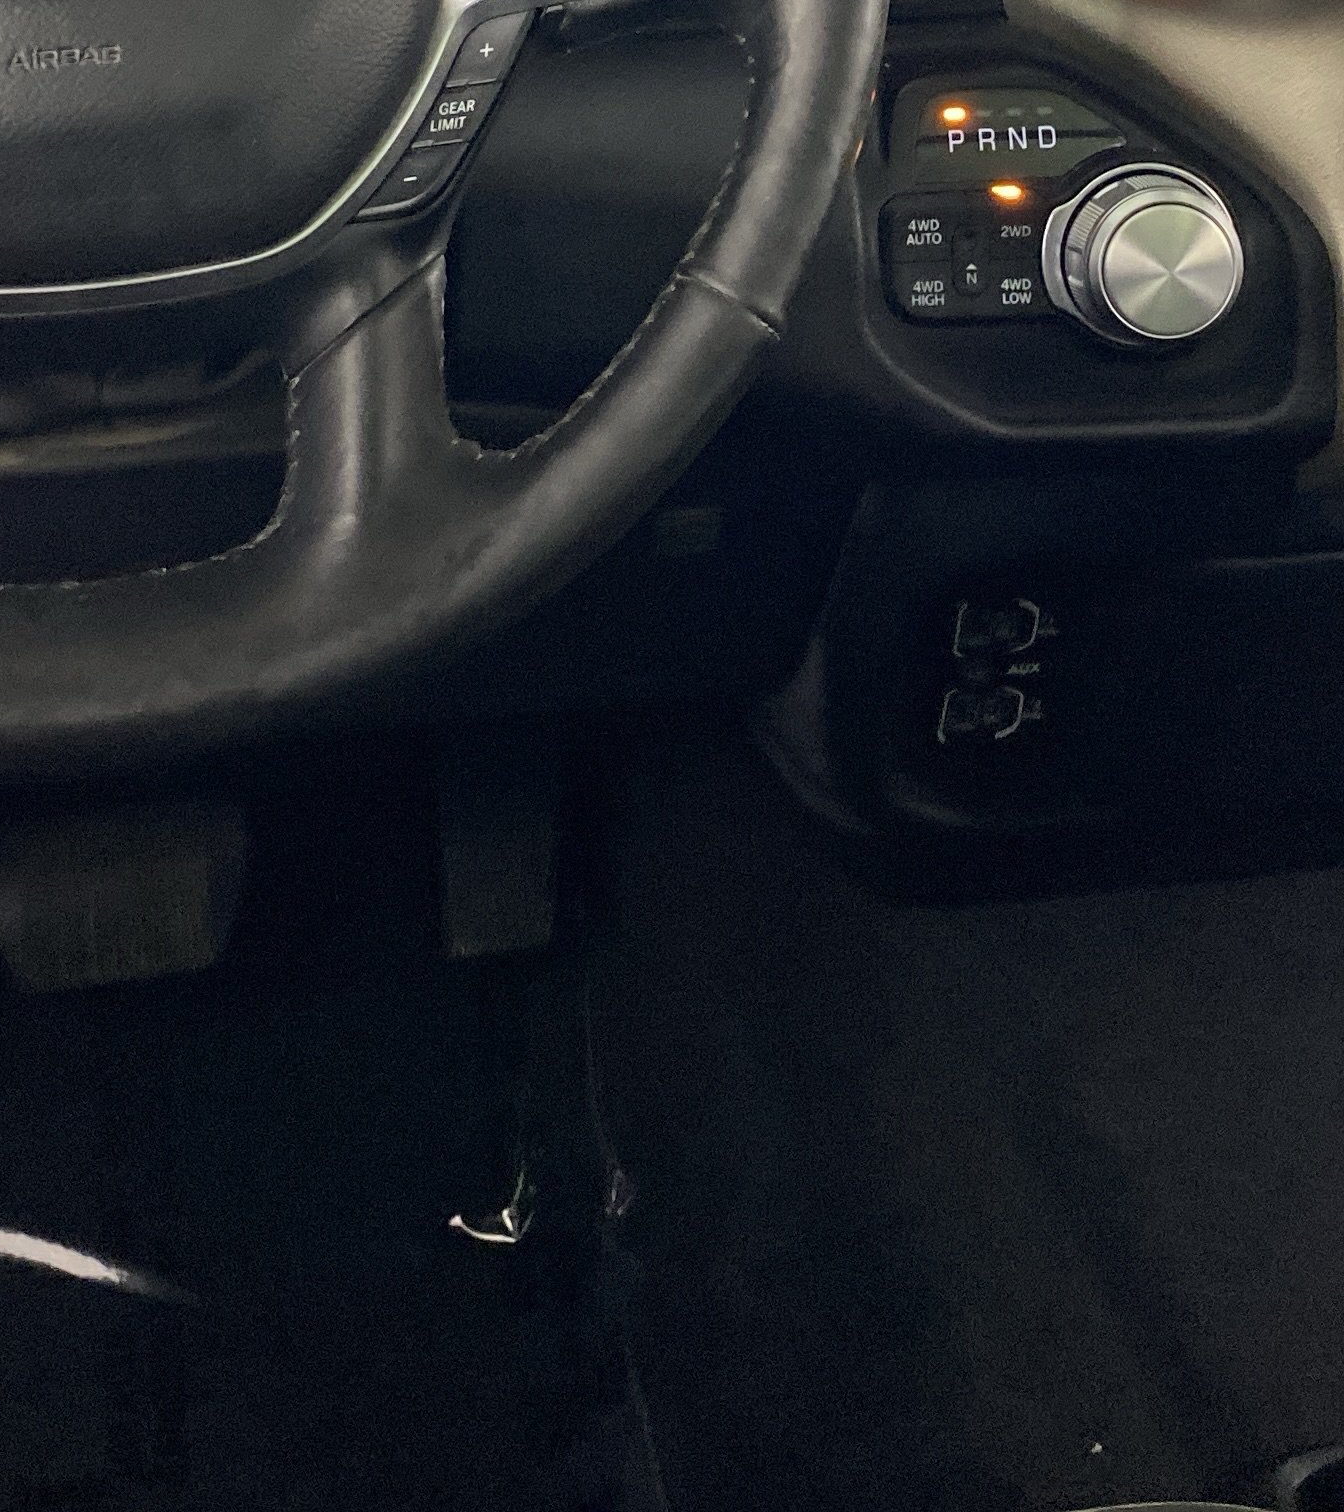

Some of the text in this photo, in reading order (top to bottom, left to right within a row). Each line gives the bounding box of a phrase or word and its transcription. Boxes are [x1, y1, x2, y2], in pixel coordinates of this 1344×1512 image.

[8, 44, 123, 74] AIRBAG
[438, 99, 476, 116] GEAR
[430, 116, 466, 133] LIMIT
[908, 218, 940, 232] 4WD
[1000, 224, 1032, 237] 2WD
[906, 232, 942, 246] AUTO
[912, 280, 944, 294] 4WD
[1001, 277, 1032, 291] 4WD
[911, 293, 945, 307] HIGH
[1002, 291, 1032, 305] LOW
